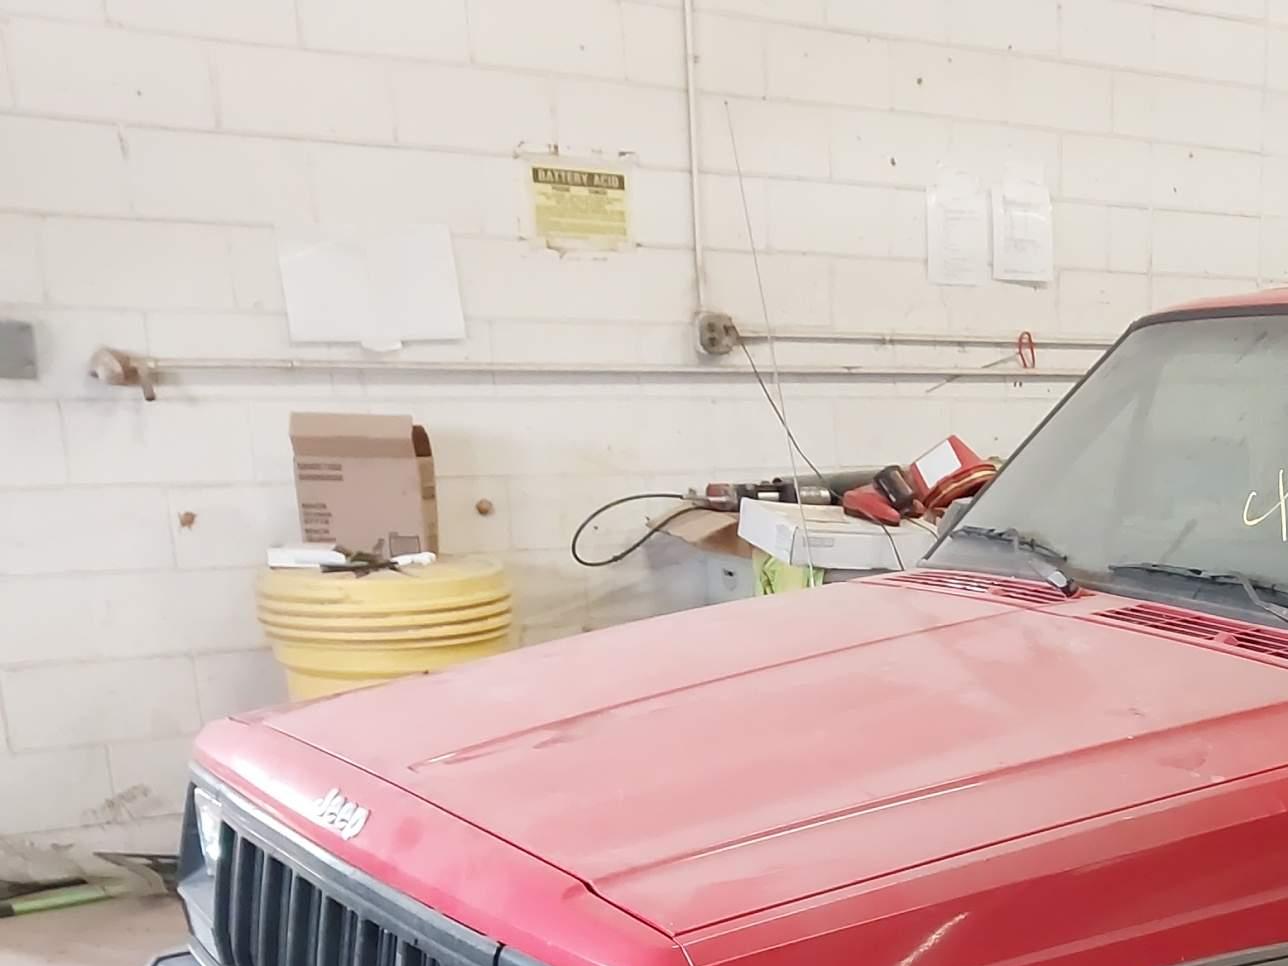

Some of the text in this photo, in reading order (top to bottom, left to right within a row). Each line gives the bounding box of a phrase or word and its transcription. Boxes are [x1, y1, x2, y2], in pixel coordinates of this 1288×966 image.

[537, 167, 620, 188] BATTERY ACID
[312, 787, 371, 840] Jeep
